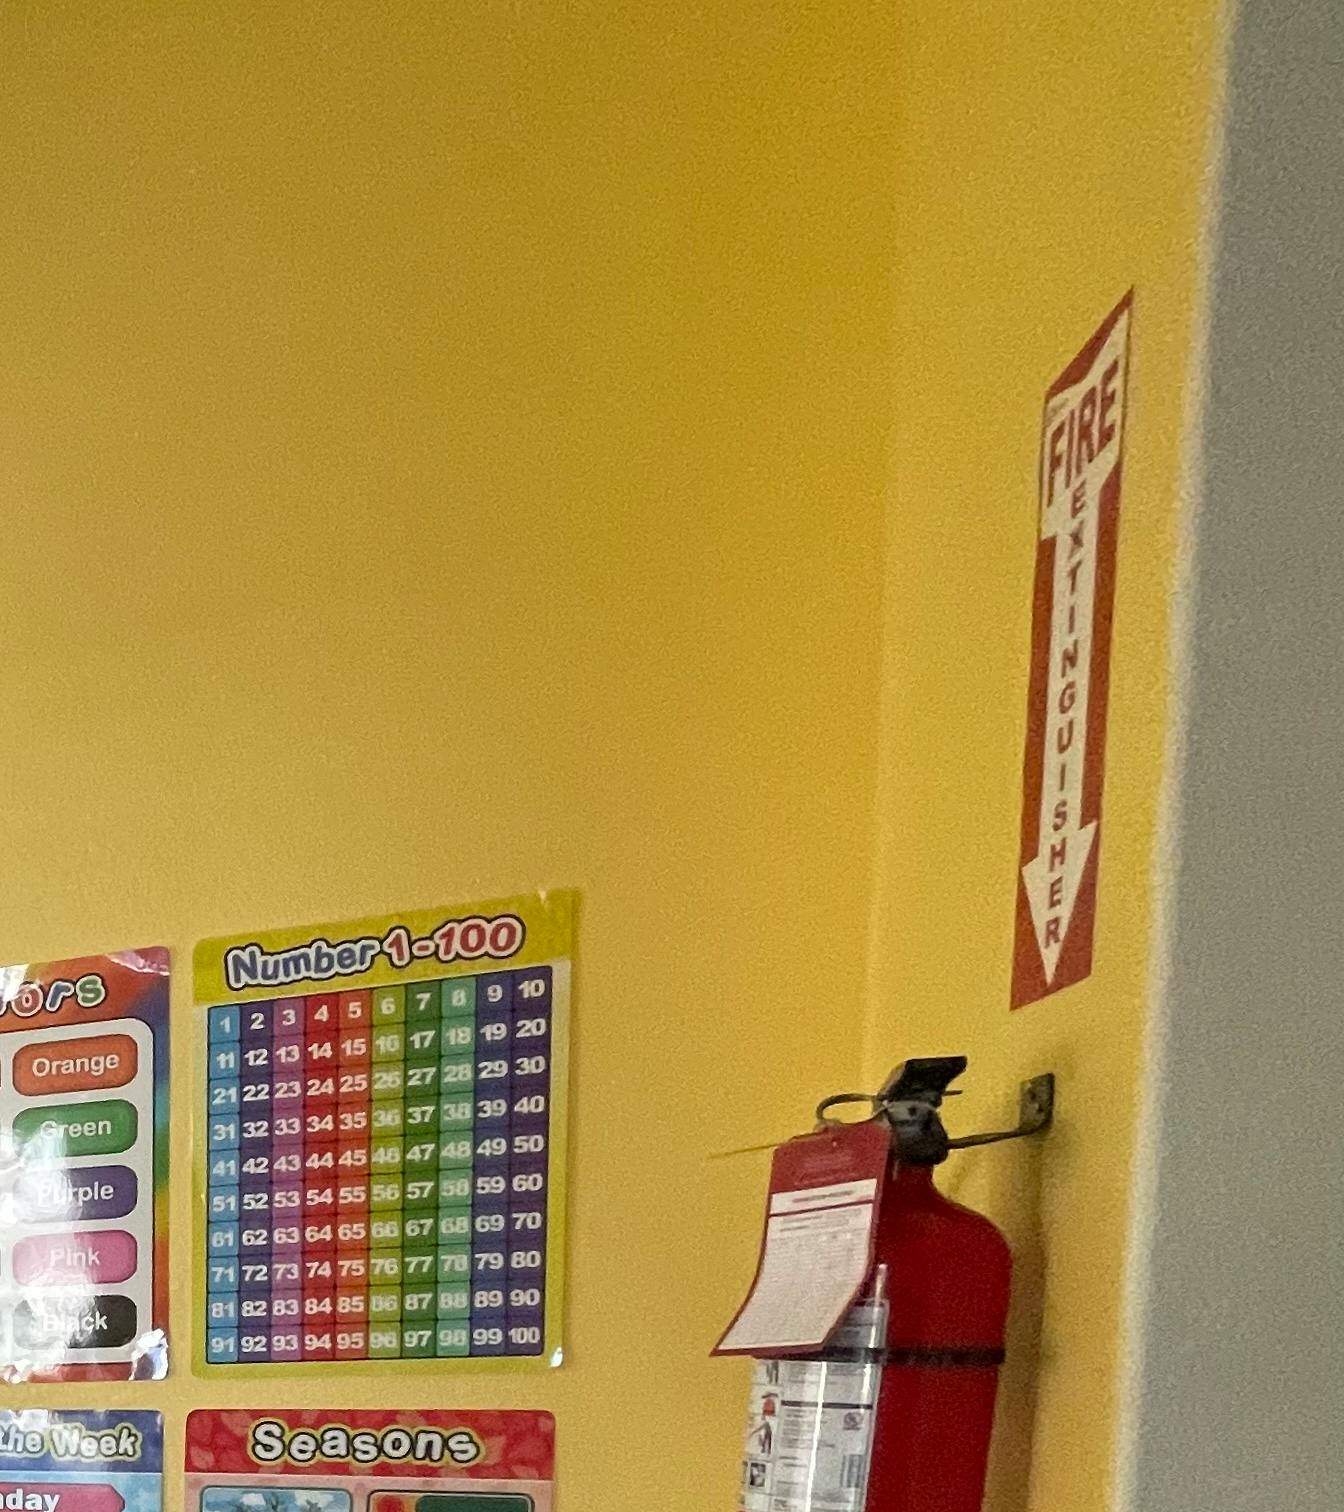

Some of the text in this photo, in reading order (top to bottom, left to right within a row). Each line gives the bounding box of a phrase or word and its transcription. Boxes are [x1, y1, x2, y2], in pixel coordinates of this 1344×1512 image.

[1047, 359, 1119, 508] FIRE
[1044, 478, 1087, 949] EXTINGUISHER
[226, 915, 524, 989] Number 1-100
[220, 1016, 231, 1034] 1
[250, 1012, 265, 1030] 2
[282, 1009, 296, 1026] 3
[314, 1004, 329, 1022] 4
[348, 1001, 362, 1018] 5
[381, 997, 395, 1014] 6
[415, 992, 432, 1011] 7
[487, 984, 503, 1003] 9
[518, 979, 546, 999] 10
[32, 1053, 120, 1077] Orange
[216, 1051, 235, 1069] 11
[244, 1048, 269, 1066] 12
[275, 1044, 300, 1063] 13
[307, 1042, 333, 1060] 14
[341, 1038, 367, 1056] 15
[410, 1029, 436, 1049] 17
[446, 1026, 472, 1045] 18
[480, 1022, 507, 1041] 19
[515, 1018, 546, 1038] 20
[212, 1087, 237, 1105] 21
[242, 1083, 270, 1102] 22
[274, 1080, 302, 1099] 23
[306, 1078, 335, 1096] 24
[339, 1074, 368, 1093] 25
[407, 1067, 437, 1086] 27
[477, 1060, 509, 1079] 29
[514, 1055, 546, 1076] 30
[39, 1119, 112, 1140] Green
[38, 1180, 114, 1206] Purple
[50, 1247, 101, 1268] Pink
[50, 1424, 140, 1460] Week
[250, 1419, 481, 1466] Seasons
